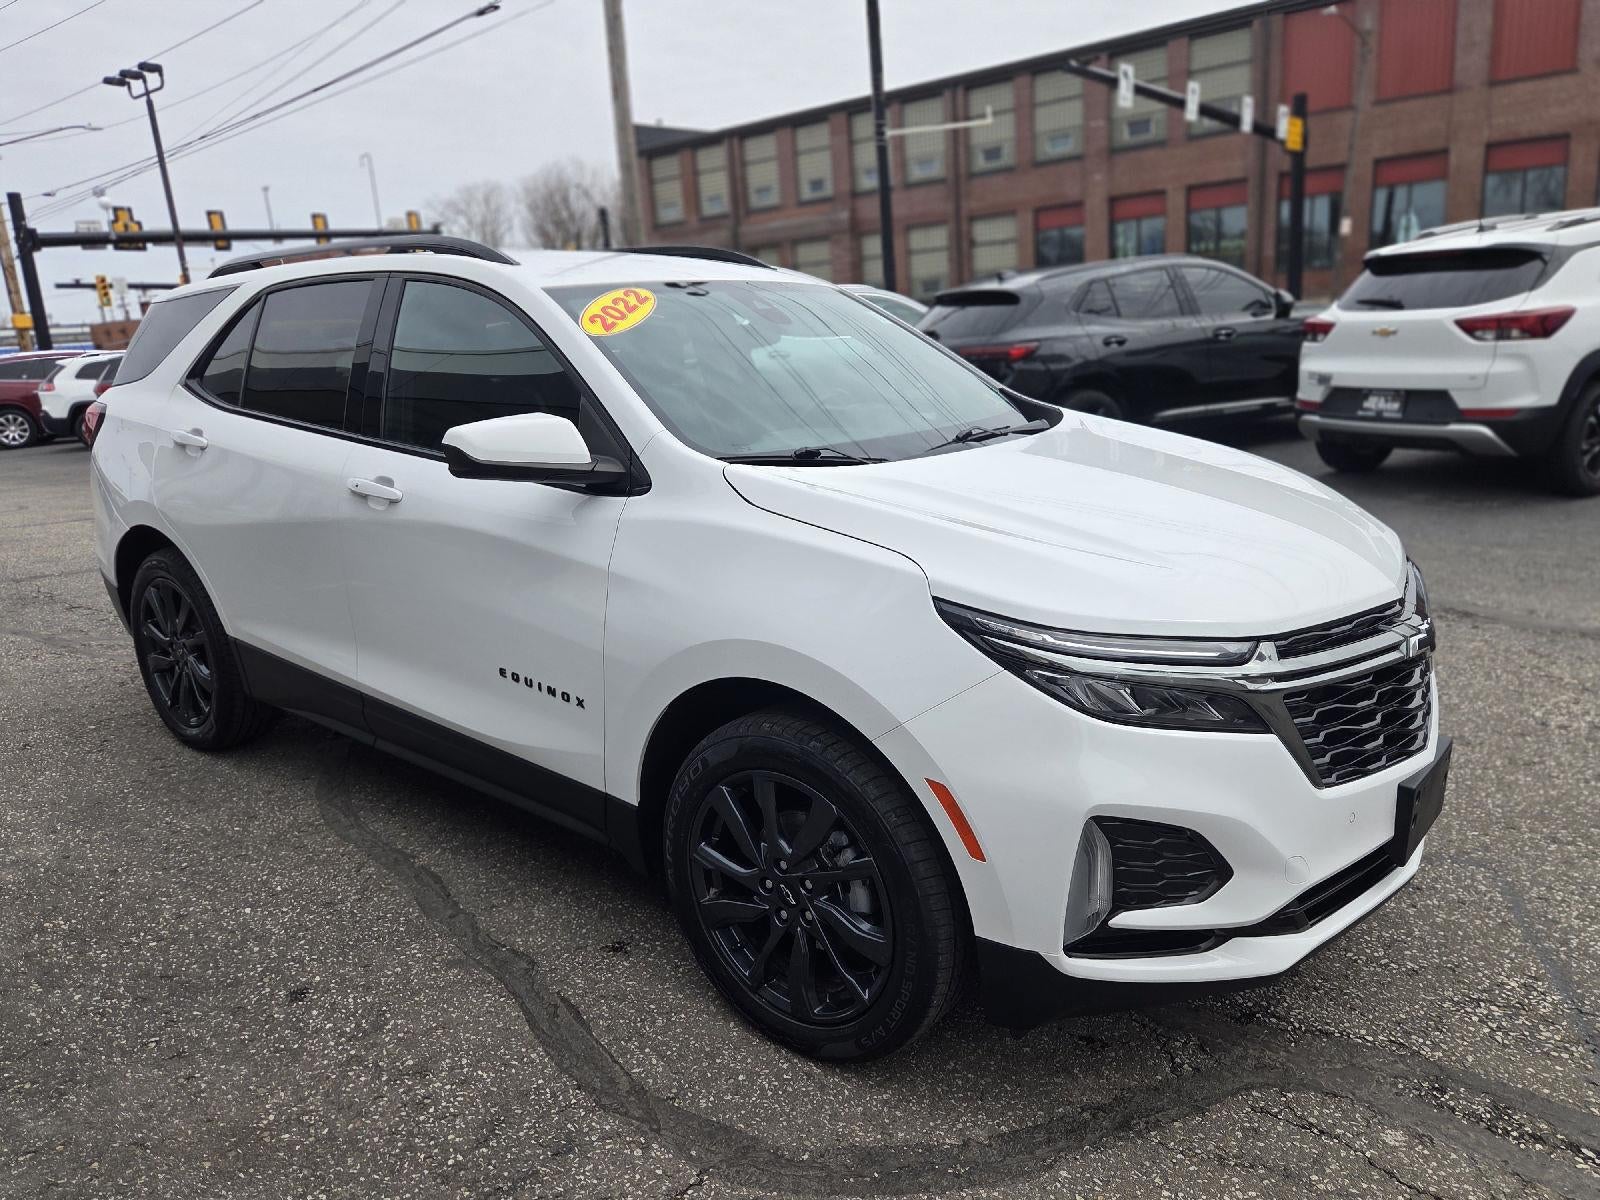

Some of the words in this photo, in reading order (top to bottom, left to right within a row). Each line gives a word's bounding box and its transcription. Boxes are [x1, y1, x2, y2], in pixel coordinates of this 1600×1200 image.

[588, 289, 650, 333] 2022
[498, 667, 586, 710] EQUINOX
[885, 977, 914, 1030] SPORT
